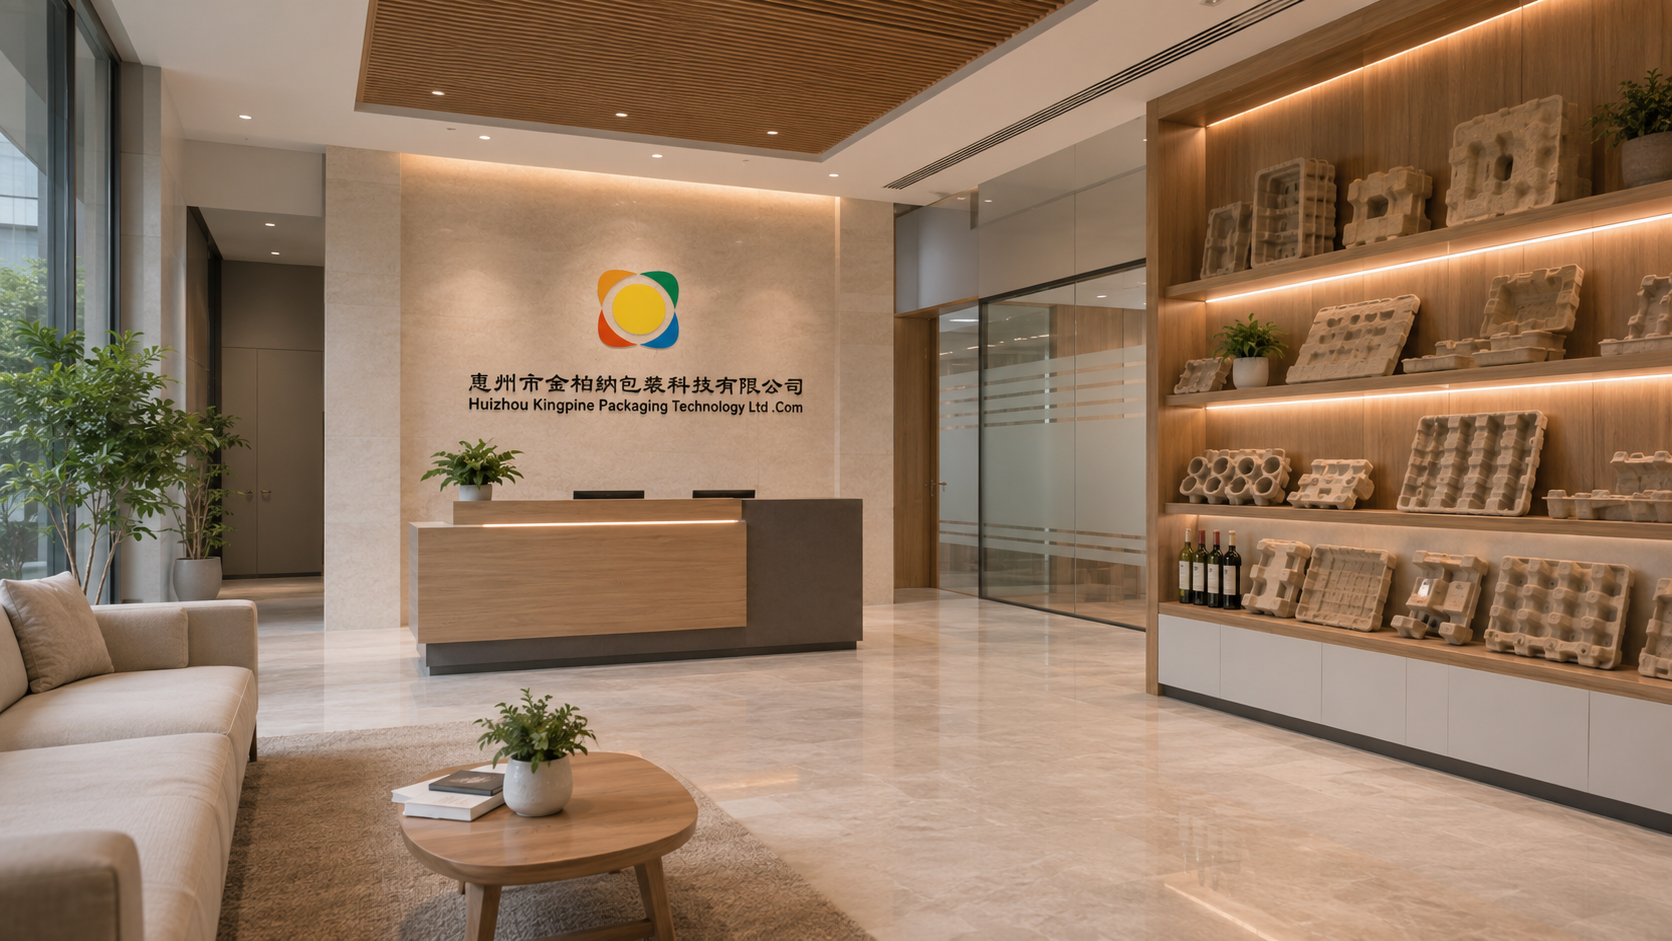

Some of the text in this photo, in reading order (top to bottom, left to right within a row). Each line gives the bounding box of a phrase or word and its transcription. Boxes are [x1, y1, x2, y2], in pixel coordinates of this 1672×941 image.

[468, 372, 803, 396] 惠州市金柏纳包装科技有限公司
[468, 397, 804, 416] Huizhou Kingpine Packaging Technology Ltd .Com
